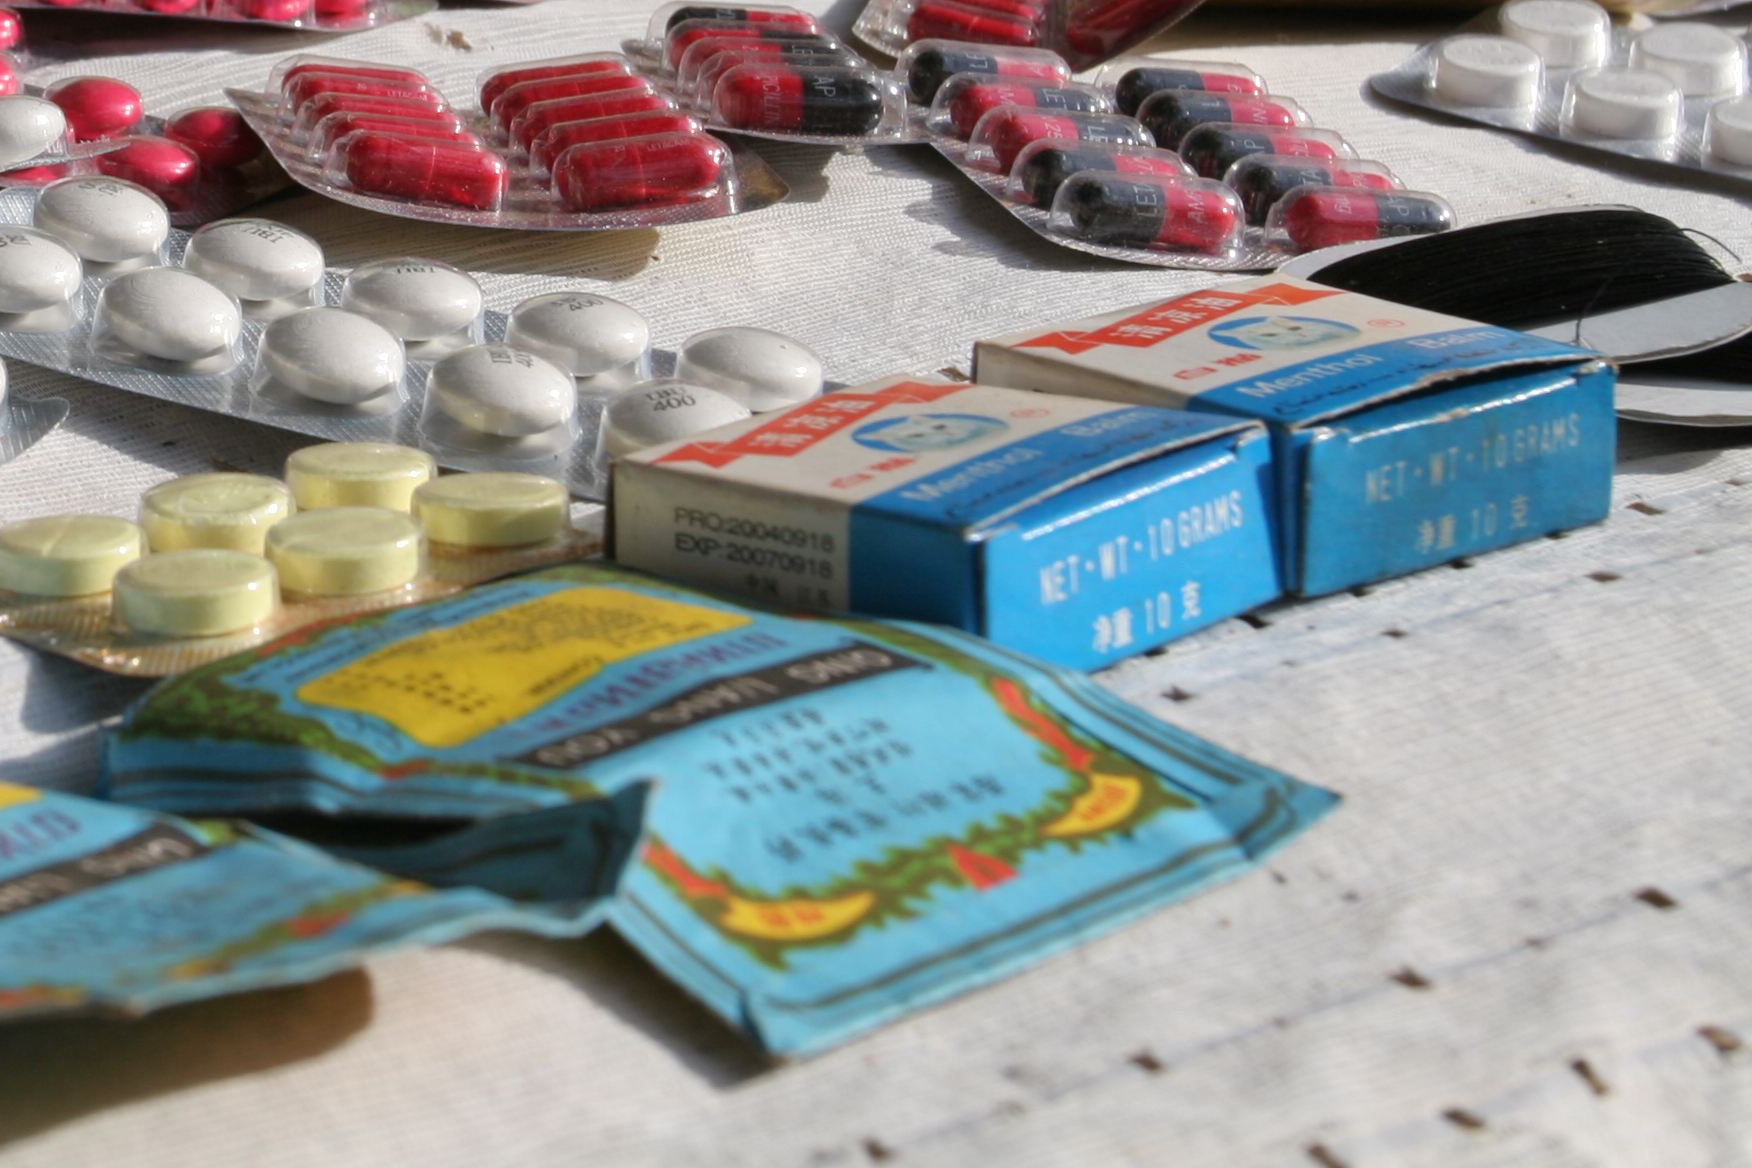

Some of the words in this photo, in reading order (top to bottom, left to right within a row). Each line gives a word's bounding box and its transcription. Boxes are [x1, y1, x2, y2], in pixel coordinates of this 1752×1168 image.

[1234, 350, 1384, 400] Menthol
[1406, 325, 1506, 350] Balm
[652, 393, 697, 412] 400
[899, 445, 1044, 504] Menthol
[672, 506, 836, 554] PRO:20040918
[1178, 489, 1243, 548] GRAMS
[673, 532, 834, 581] EXP:20070918
[1142, 591, 1174, 633] 10
